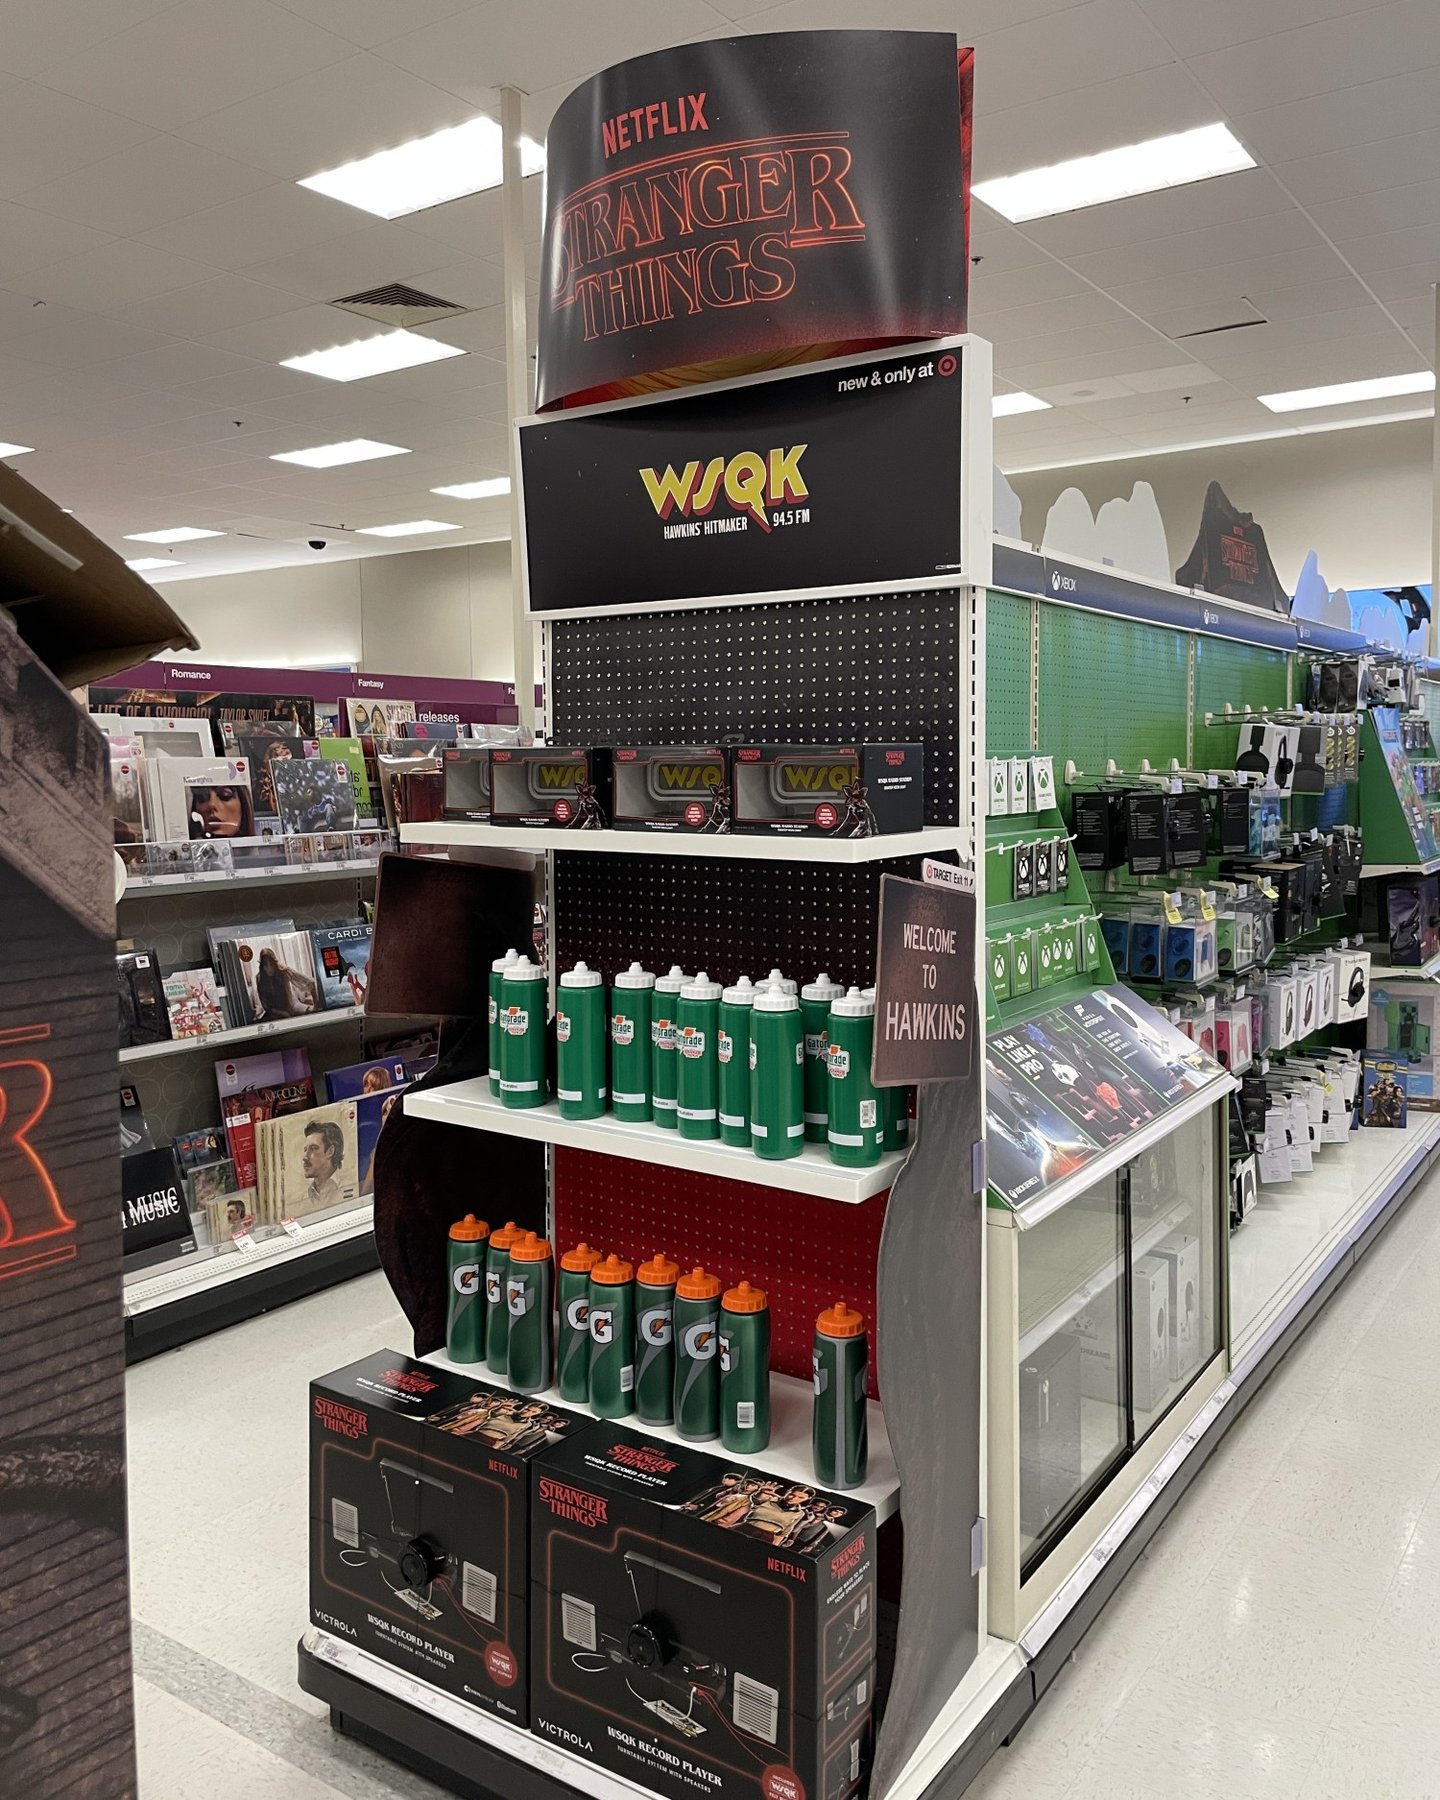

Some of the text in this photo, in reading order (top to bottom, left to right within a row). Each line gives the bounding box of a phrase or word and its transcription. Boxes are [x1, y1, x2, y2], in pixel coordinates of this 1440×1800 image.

[602, 91, 710, 159] NETFLIX
[551, 145, 866, 300] STRANGER
[574, 231, 797, 342] THINGS
[838, 361, 934, 393] new & only at
[639, 444, 810, 534] WSQK
[703, 516, 748, 536] HITMAKER
[772, 511, 794, 528] 94.5
[795, 508, 810, 525] FM
[1060, 576, 1076, 592] XBOX
[171, 668, 212, 680] Romance
[357, 678, 384, 690] Fantasy
[418, 710, 460, 723] releases
[933, 867, 952, 882] TARGET
[953, 872, 963, 886] Exit
[328, 929, 362, 940] CARDI
[903, 923, 957, 955] WELCOME
[922, 964, 937, 990] TO
[885, 1002, 966, 1041] HAWKINS
[992, 1034, 1021, 1052] PLAY
[1006, 1044, 1039, 1064] LIKE A
[1020, 1058, 1044, 1076] PRO
[127, 1186, 180, 1227] MUSIC
[452, 1263, 480, 1296] G
[588, 1309, 615, 1345] G
[640, 1309, 673, 1347] G
[684, 1320, 718, 1360] G
[314, 1396, 368, 1435] STRANGER
[322, 1416, 360, 1440] THINGS
[488, 1458, 519, 1480] NETFLIX
[583, 1454, 607, 1466] WSQK
[606, 1461, 638, 1476] RECORD
[637, 1473, 668, 1486] PLAYER
[606, 1444, 680, 1474] STRANGER
[612, 1454, 656, 1473] THINGS
[539, 1478, 609, 1523] STRANGER
[548, 1500, 598, 1529] THINGS
[767, 1556, 806, 1584] NETFLIX
[314, 1608, 358, 1638] VICTROLA
[367, 1613, 455, 1664] WSQK RECORD PLAYER
[537, 1717, 594, 1753] VICTROLA
[607, 1725, 723, 1788] WSQK RECORD PLAYER
[668, 1768, 683, 1781] WITH
[683, 1774, 711, 1795] SPEAKERS
[771, 1781, 797, 1799] WSQK
